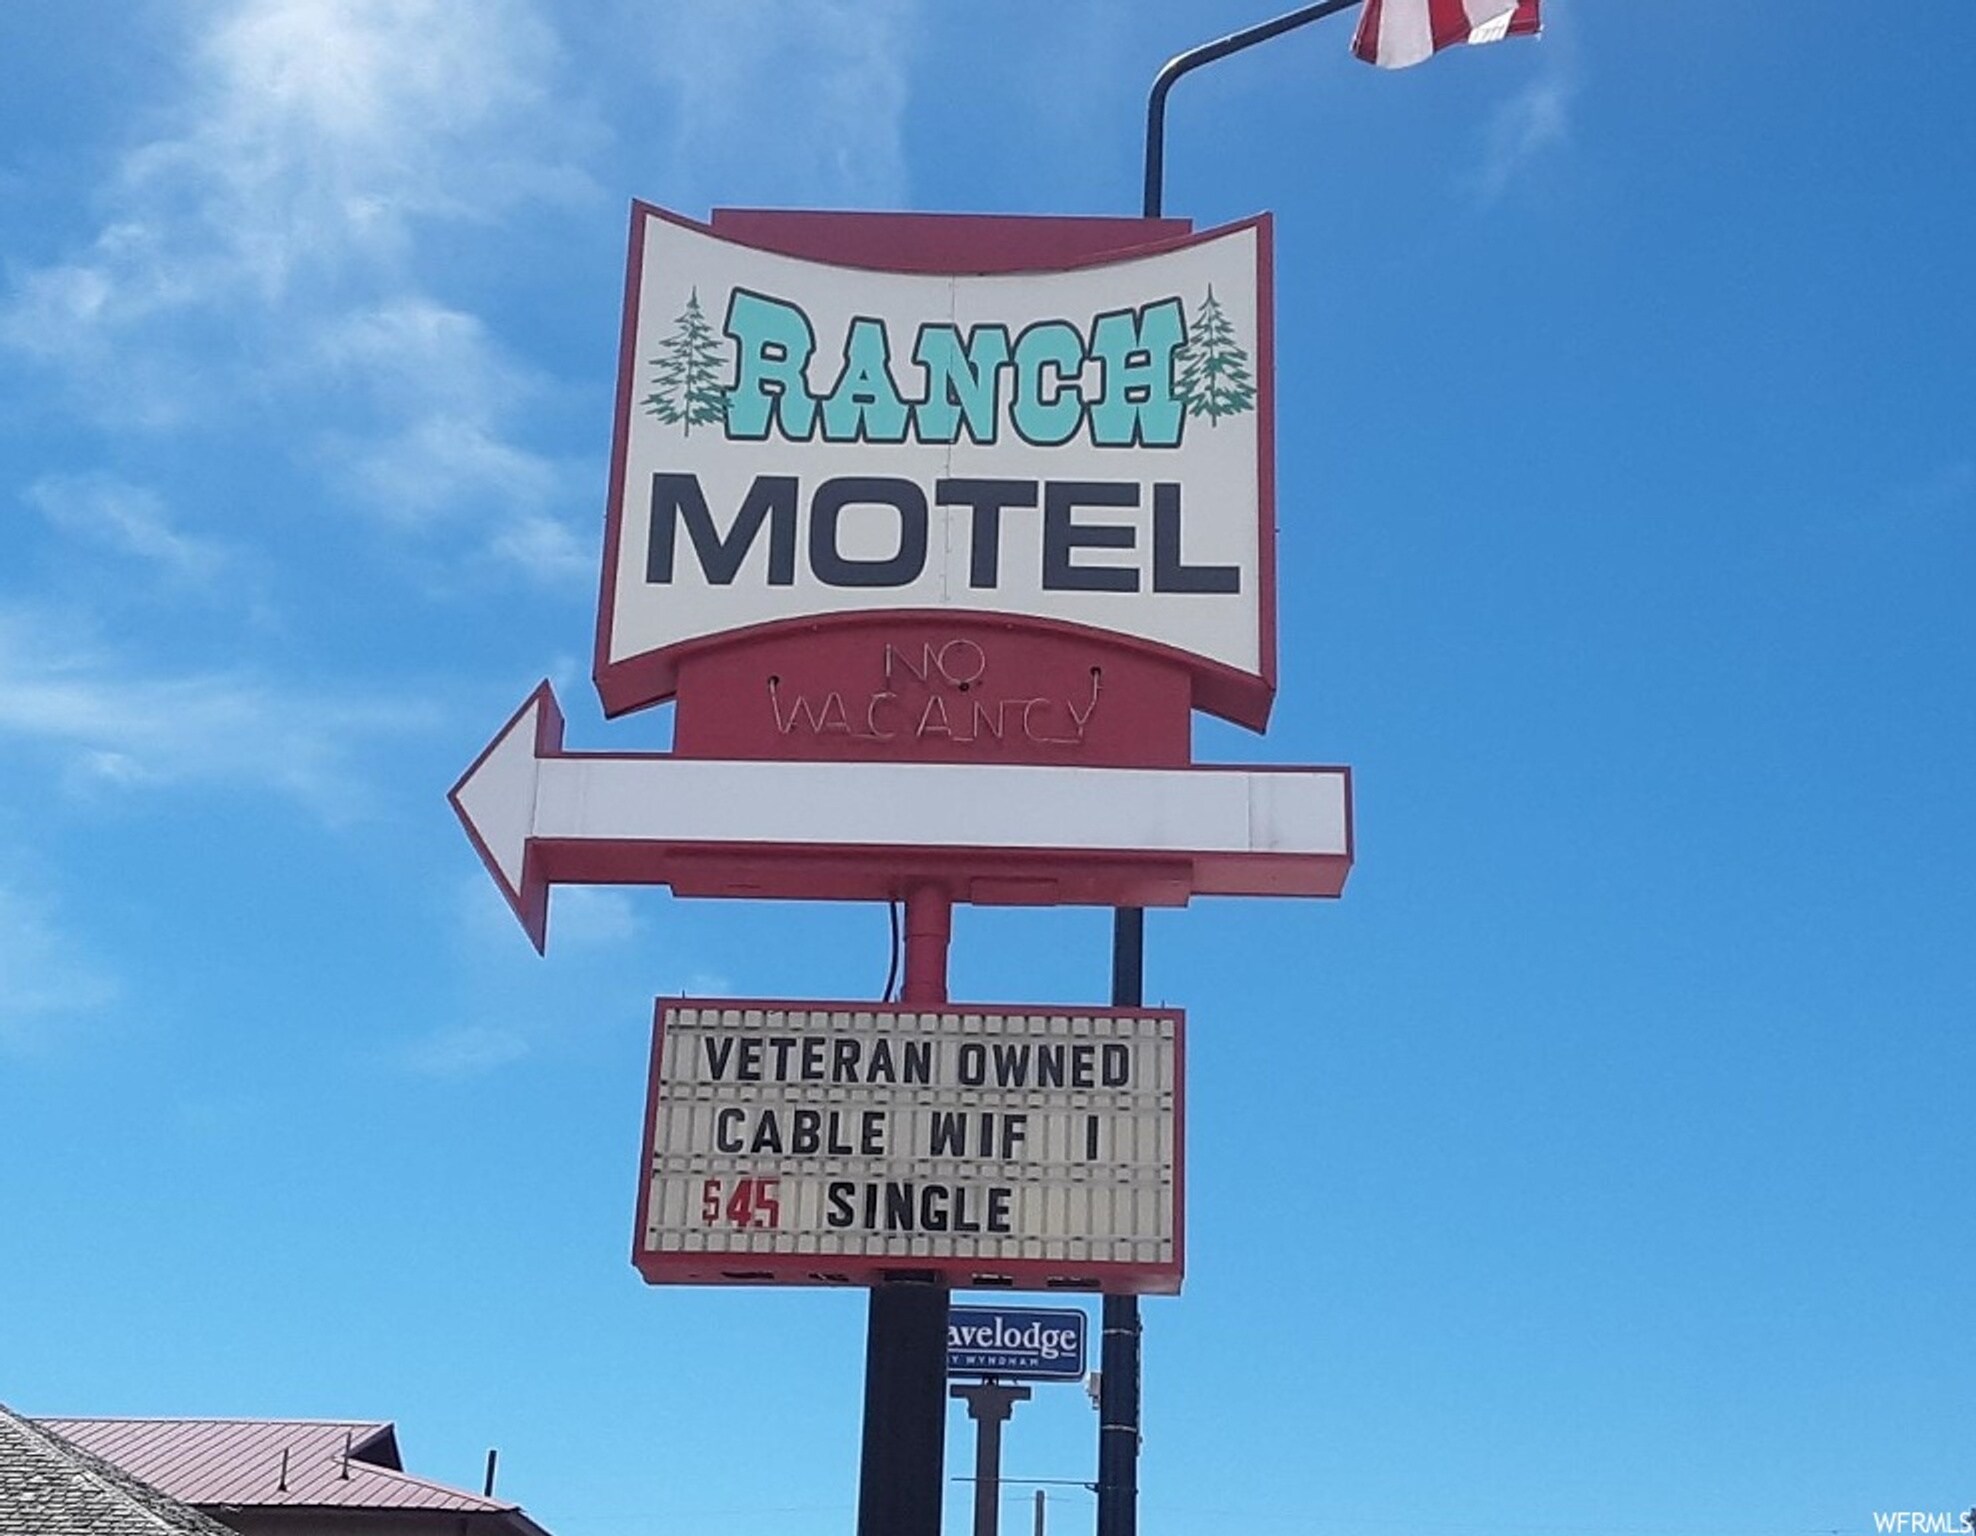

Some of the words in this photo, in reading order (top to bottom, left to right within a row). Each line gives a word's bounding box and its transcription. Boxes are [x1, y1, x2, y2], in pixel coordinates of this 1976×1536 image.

[722, 287, 1188, 449] RANCH
[645, 473, 1241, 594] MOTEL
[884, 639, 985, 684] NO
[705, 1036, 931, 1085] VETERAN
[957, 1042, 1130, 1088] OWNED
[716, 1107, 886, 1156] CABLE
[702, 1178, 780, 1229] $45
[826, 1181, 1013, 1233] SINGLE
[947, 1316, 1077, 1358] avelodge
[966, 1355, 1040, 1368] WYNDHAM
